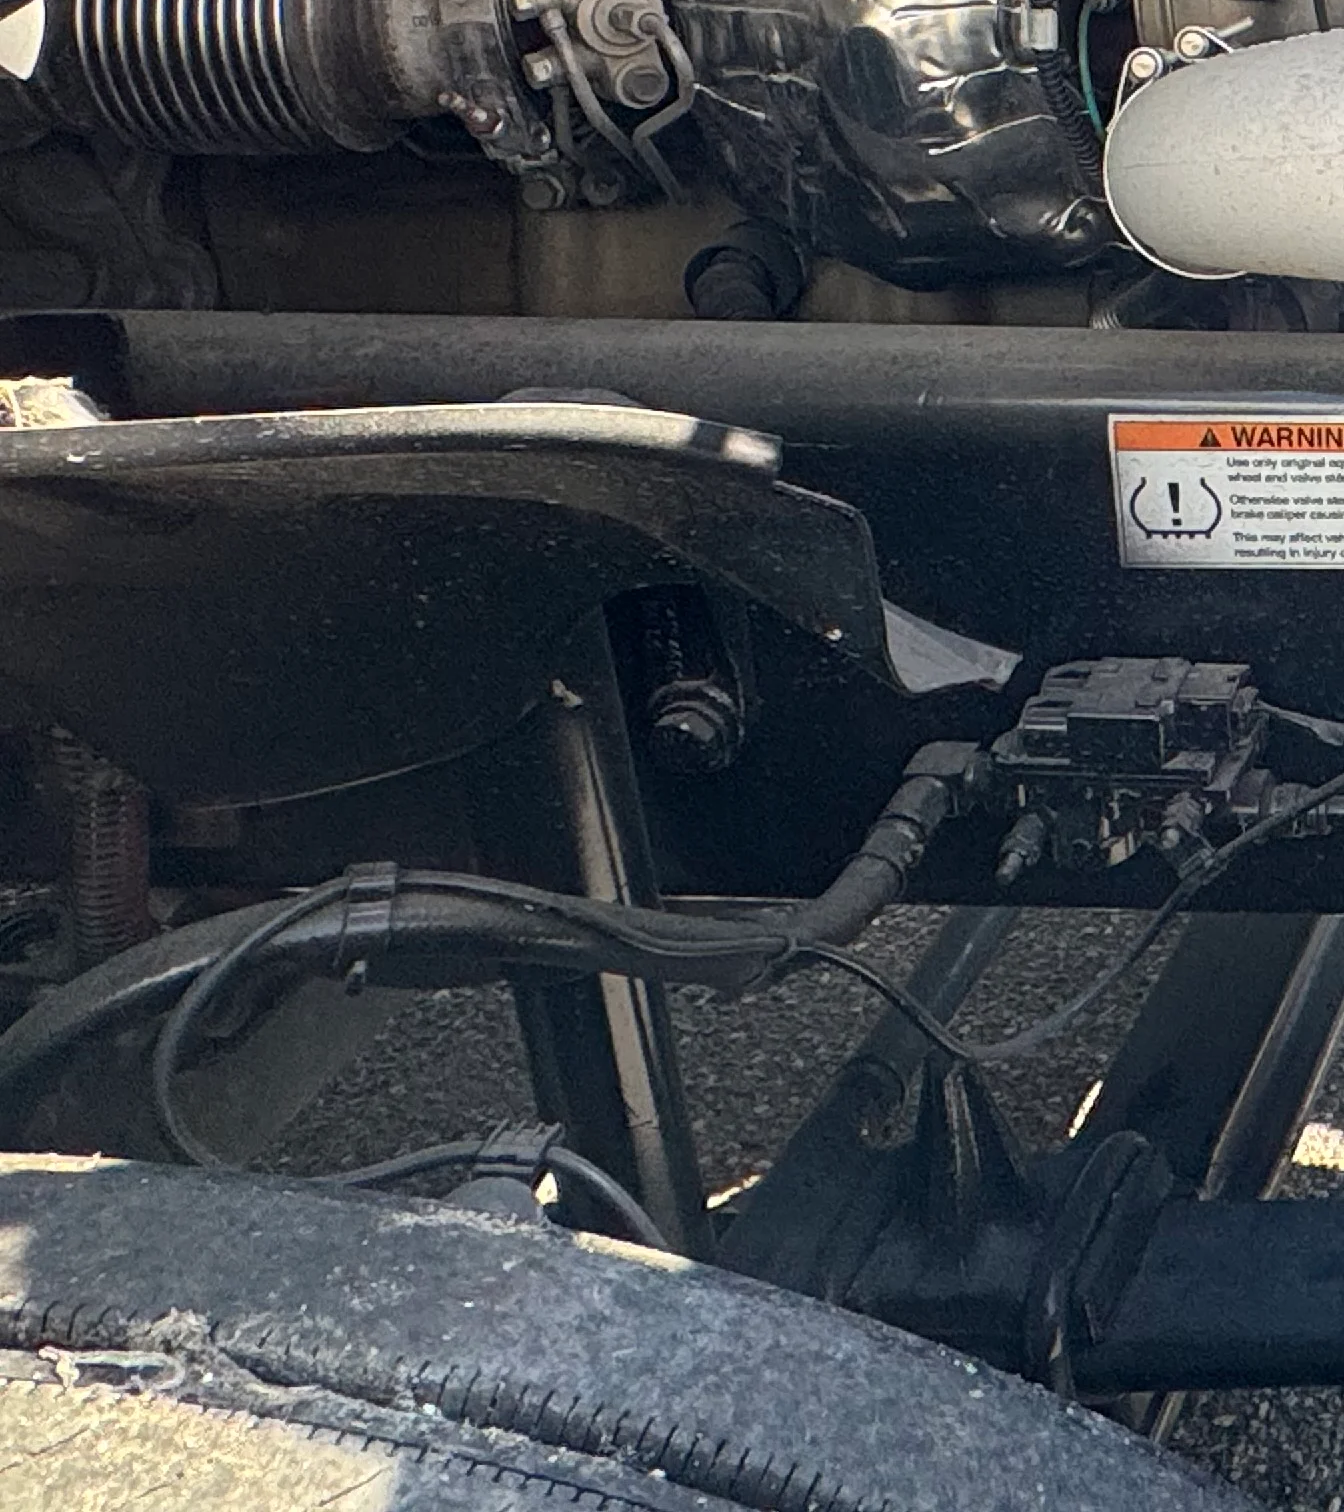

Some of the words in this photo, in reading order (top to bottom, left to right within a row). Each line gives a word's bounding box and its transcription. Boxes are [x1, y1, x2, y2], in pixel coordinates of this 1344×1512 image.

[1227, 456, 1250, 468] Use
[1253, 457, 1277, 469] only
[1281, 456, 1325, 471] original
[1227, 472, 1261, 483] wheel
[1265, 472, 1287, 483] and
[1291, 473, 1321, 483] valve
[1229, 494, 1289, 505] Otherwise
[1293, 495, 1323, 505] valve
[1231, 509, 1264, 519] brake
[1267, 510, 1308, 522] caliper
[1233, 532, 1257, 542] This
[1261, 534, 1285, 544] may
[1289, 532, 1322, 543] affect
[1235, 548, 1285, 560] resulting
[1289, 549, 1299, 558] in
[1303, 549, 1335, 560] injury
